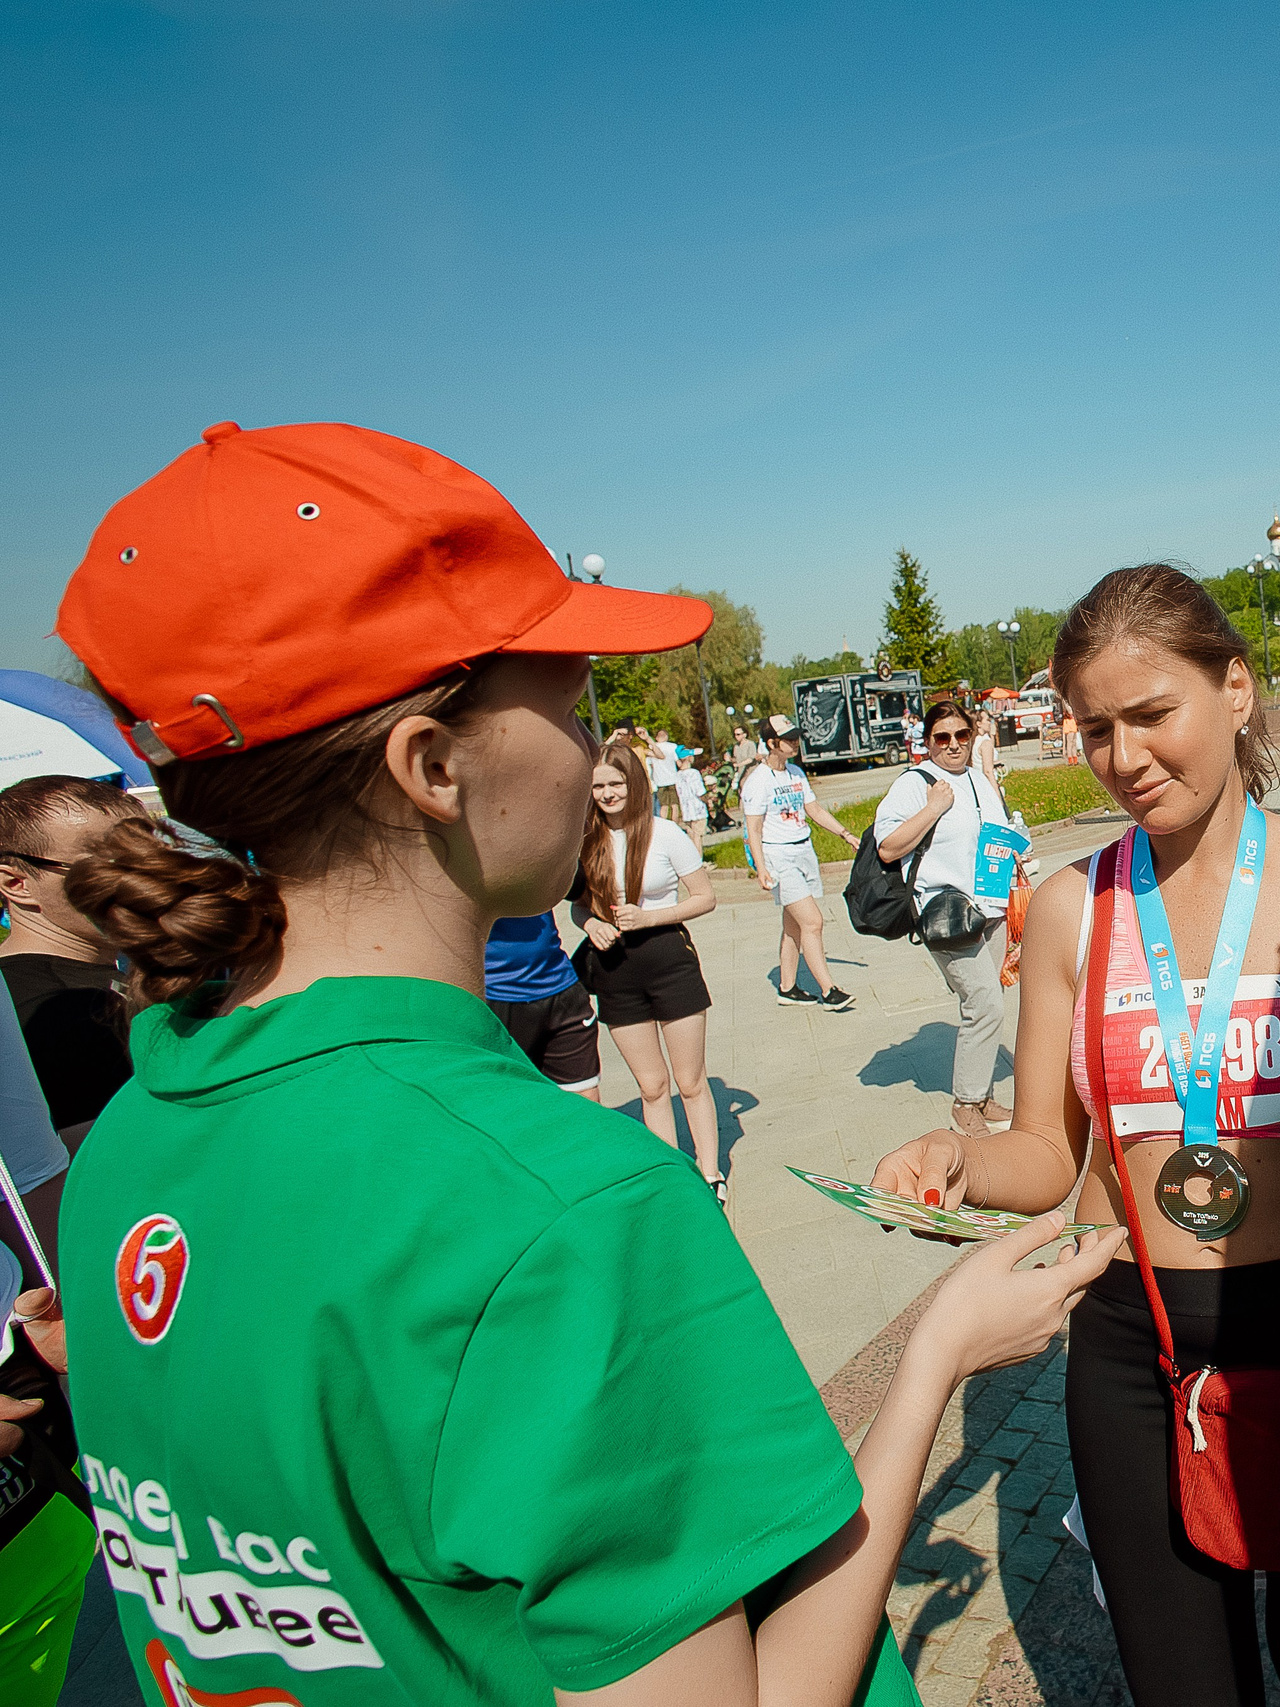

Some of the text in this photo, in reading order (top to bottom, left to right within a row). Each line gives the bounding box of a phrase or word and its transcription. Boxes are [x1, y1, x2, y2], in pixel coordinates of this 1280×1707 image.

[1243, 839, 1258, 867] ПСБ
[1156, 960, 1174, 992] ПСБ
[1135, 992, 1155, 1002] ПС
[1198, 1032, 1217, 1066] ПСБ
